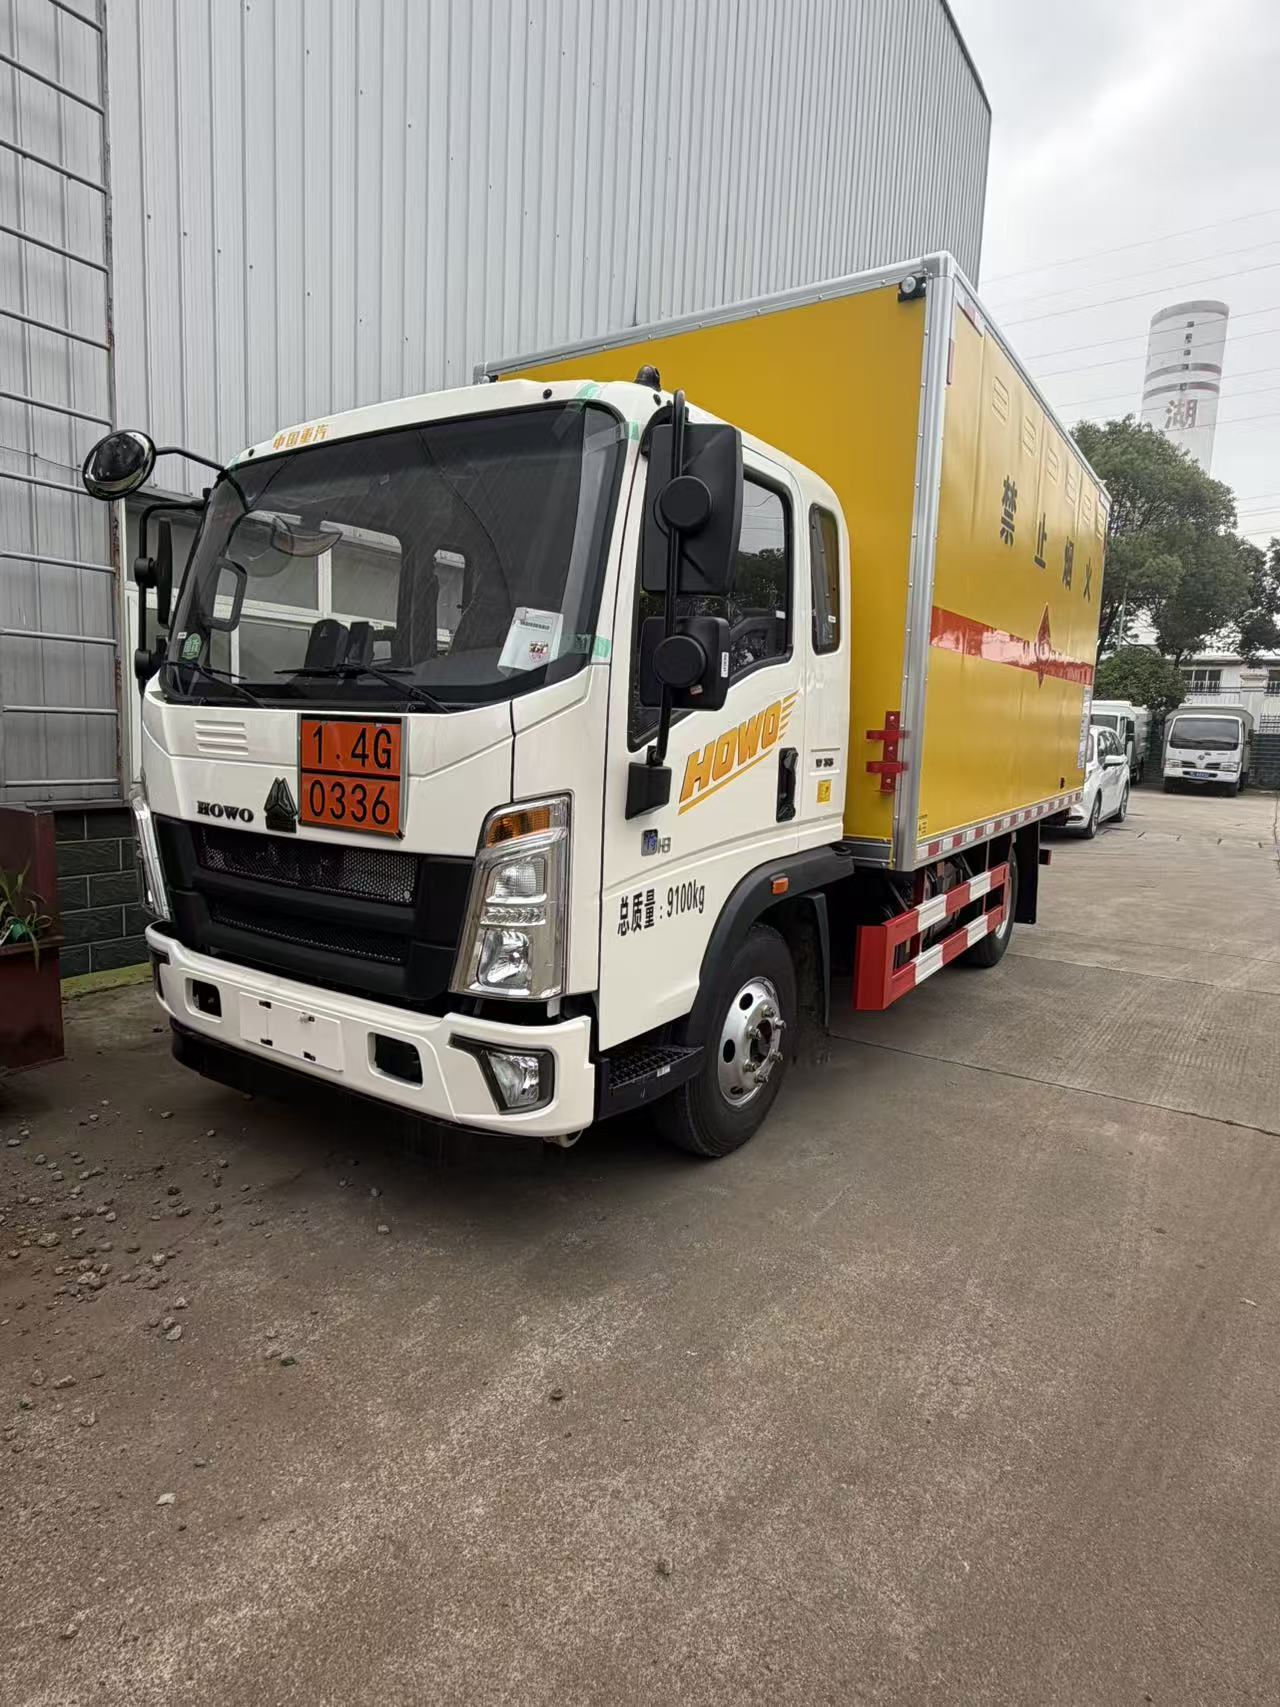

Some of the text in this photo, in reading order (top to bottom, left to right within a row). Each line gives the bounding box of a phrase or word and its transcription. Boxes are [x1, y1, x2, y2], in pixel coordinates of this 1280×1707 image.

[1165, 399, 1198, 429] 湖
[272, 424, 328, 450] 中国重汽
[1000, 475, 1092, 603] 禁止烟火
[679, 700, 782, 804] HOWO
[197, 800, 254, 823] HOWO
[309, 780, 390, 825] 0336
